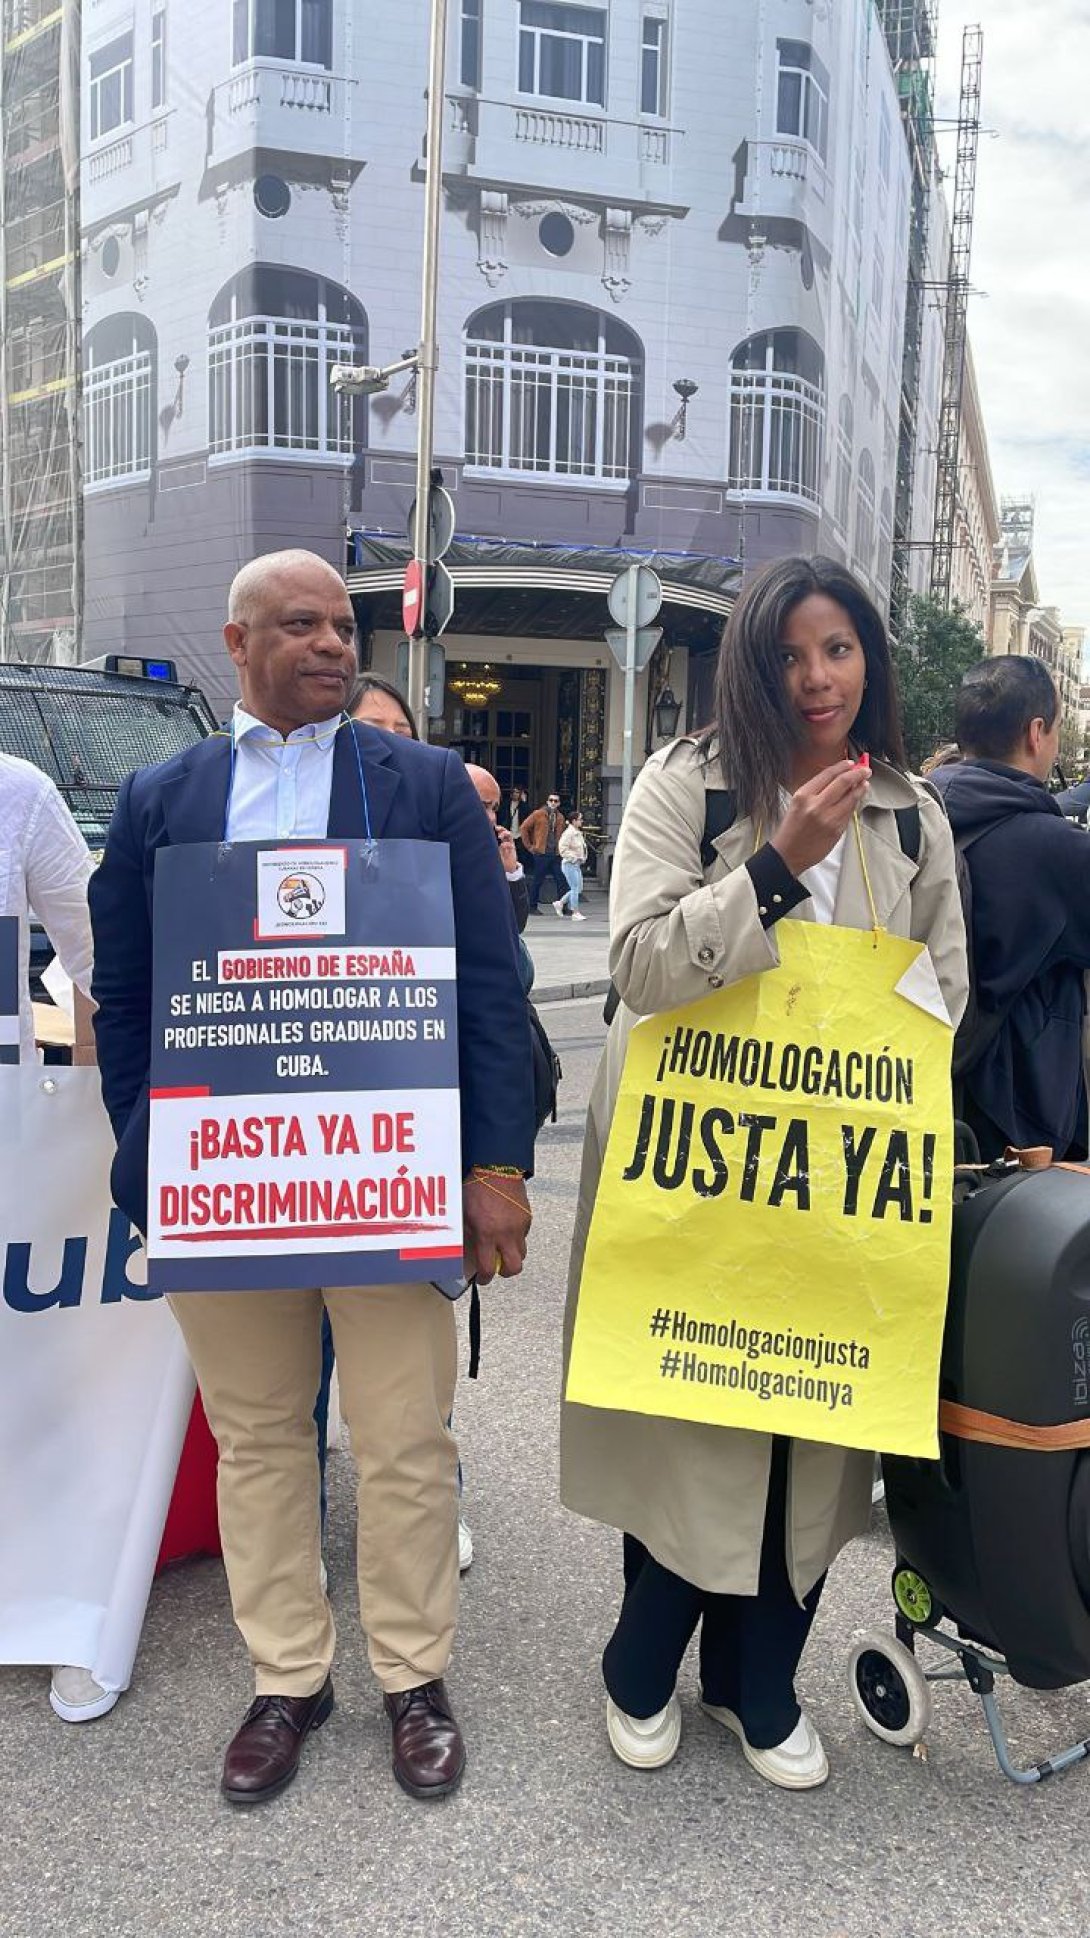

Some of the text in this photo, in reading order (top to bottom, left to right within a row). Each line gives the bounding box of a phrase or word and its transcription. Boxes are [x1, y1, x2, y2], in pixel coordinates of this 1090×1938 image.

[192, 950, 416, 981] EL GOBIERNO DE ESPAÑA
[170, 986, 438, 1016] SE NIEGA A HOMOLOGAR A LOS
[164, 1019, 446, 1050] PROFESIONALES GRADUADOS EN
[276, 1054, 329, 1077] CUBA.
[656, 1026, 914, 1105] ¡HOMOLOGACIÓN
[190, 1112, 416, 1171] ¡BASTA YA DE
[621, 1093, 937, 1224] JUSTA YA!
[159, 1164, 447, 1227] DISCRIMINACIÓN!
[650, 1307, 871, 1370] #Homologacionjusta
[659, 1348, 854, 1411] #Homologacionya
